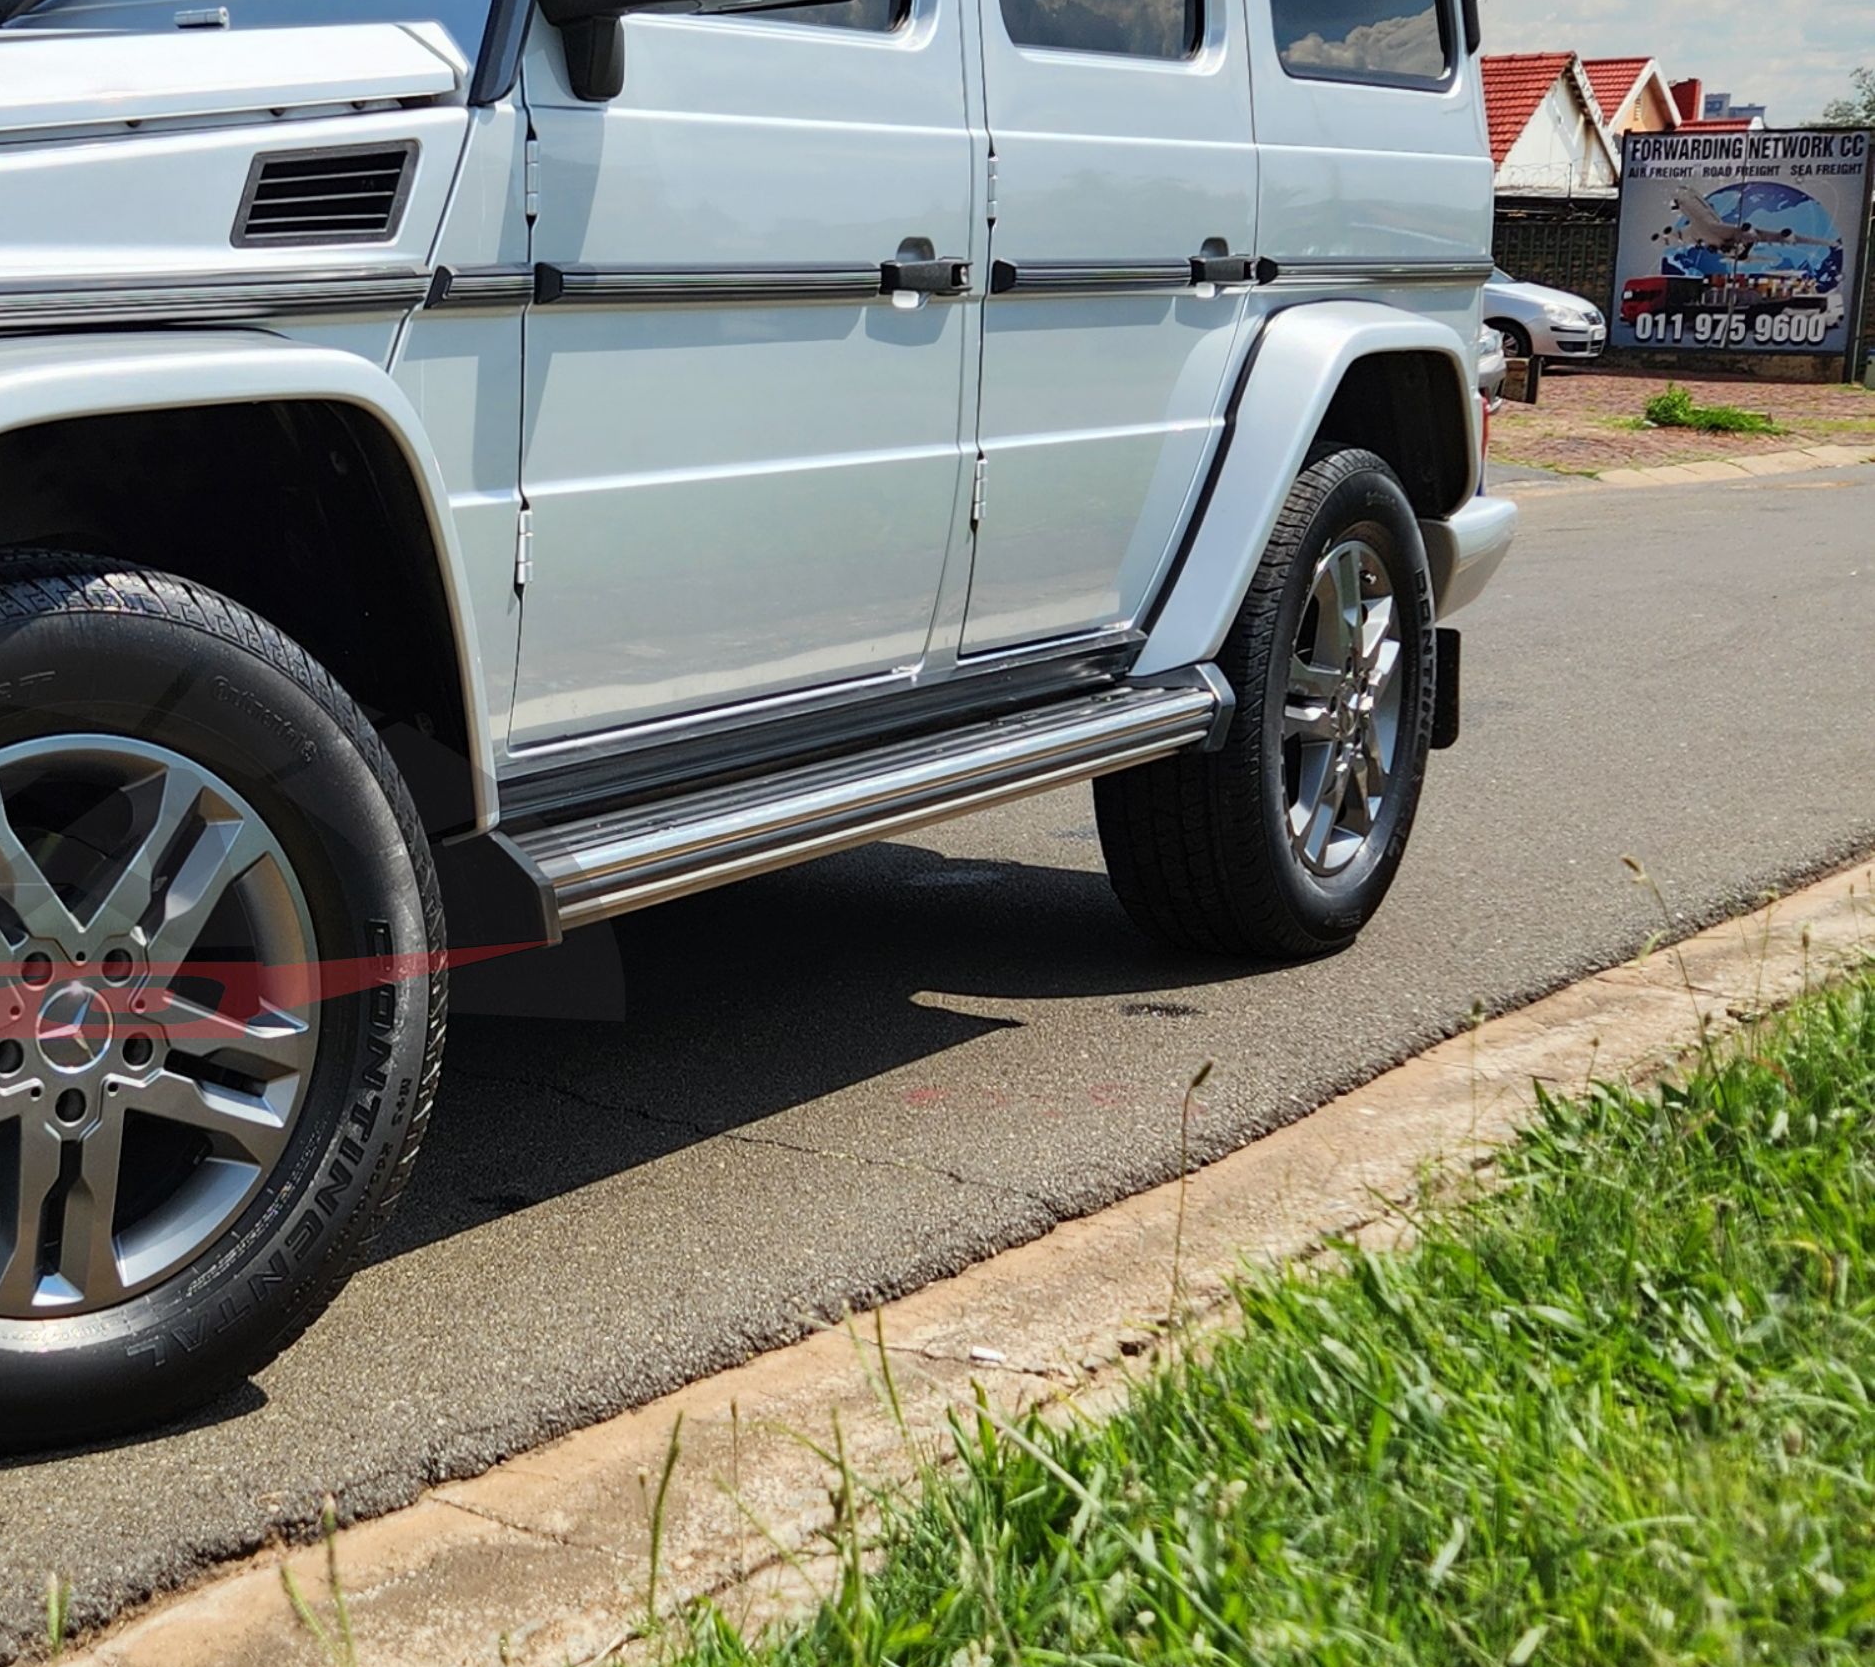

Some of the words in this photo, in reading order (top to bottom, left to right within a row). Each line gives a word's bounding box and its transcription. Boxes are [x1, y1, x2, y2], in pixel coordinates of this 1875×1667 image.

[1631, 137, 1743, 162] FORWARDING
[1748, 135, 1835, 160] NETWORK
[1840, 134, 1865, 157] CC
[1628, 166, 1647, 178] AIR
[1649, 166, 1694, 178] FREIGHT
[1702, 166, 1733, 178] ROAD
[1735, 164, 1782, 177] FREIGHT
[1790, 164, 1813, 176] SEA
[1816, 163, 1864, 176] FREIGHT
[1636, 312, 1683, 341] 011
[1695, 313, 1746, 343] 975
[1754, 313, 1827, 343] 9600
[126, 917, 398, 1368] CONTINENTAL
